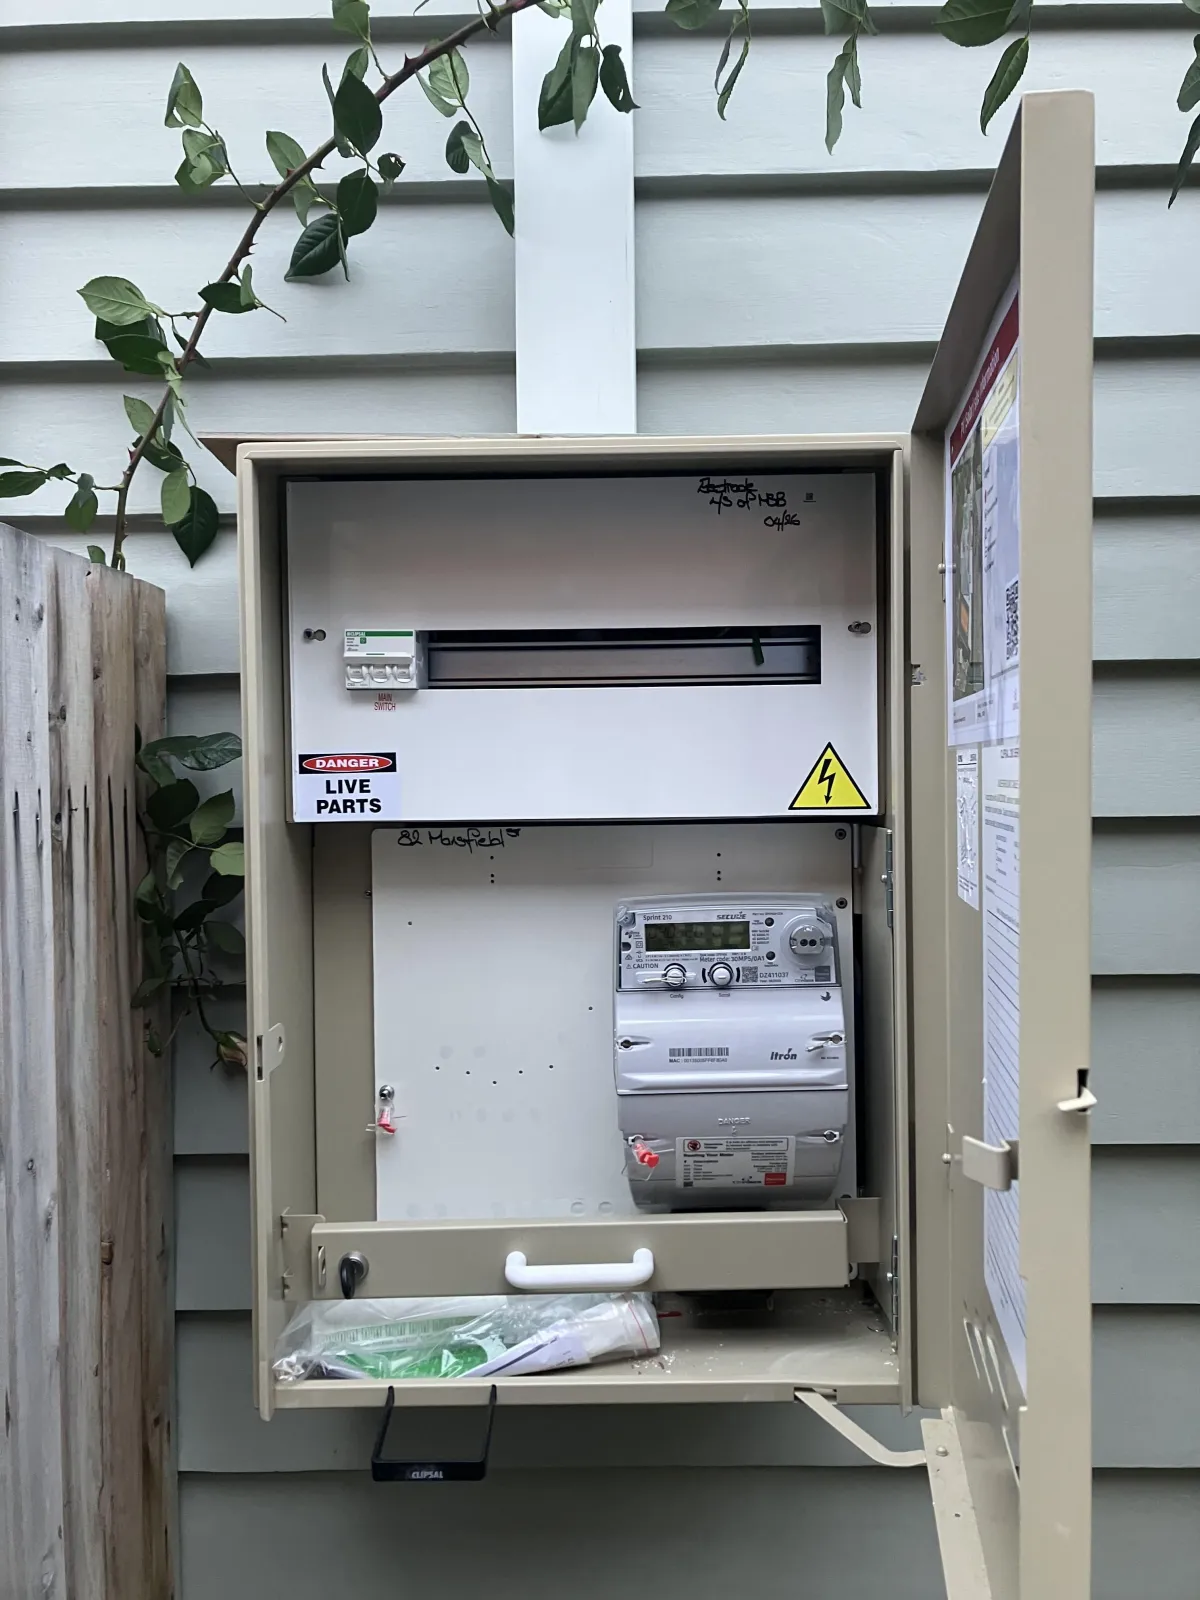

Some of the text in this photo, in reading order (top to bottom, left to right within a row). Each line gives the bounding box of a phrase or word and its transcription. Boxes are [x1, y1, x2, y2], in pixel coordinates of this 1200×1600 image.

[378, 693, 393, 701] MAIN
[374, 702, 396, 711] SWITCH
[315, 758, 380, 768] DANGER
[325, 779, 371, 794] LIVE
[316, 798, 382, 814] PARTS
[398, 829, 423, 847] 82
[716, 911, 747, 920] SECURE
[717, 1117, 751, 1126] DANGER
[411, 1471, 444, 1479] CLIPSAL
